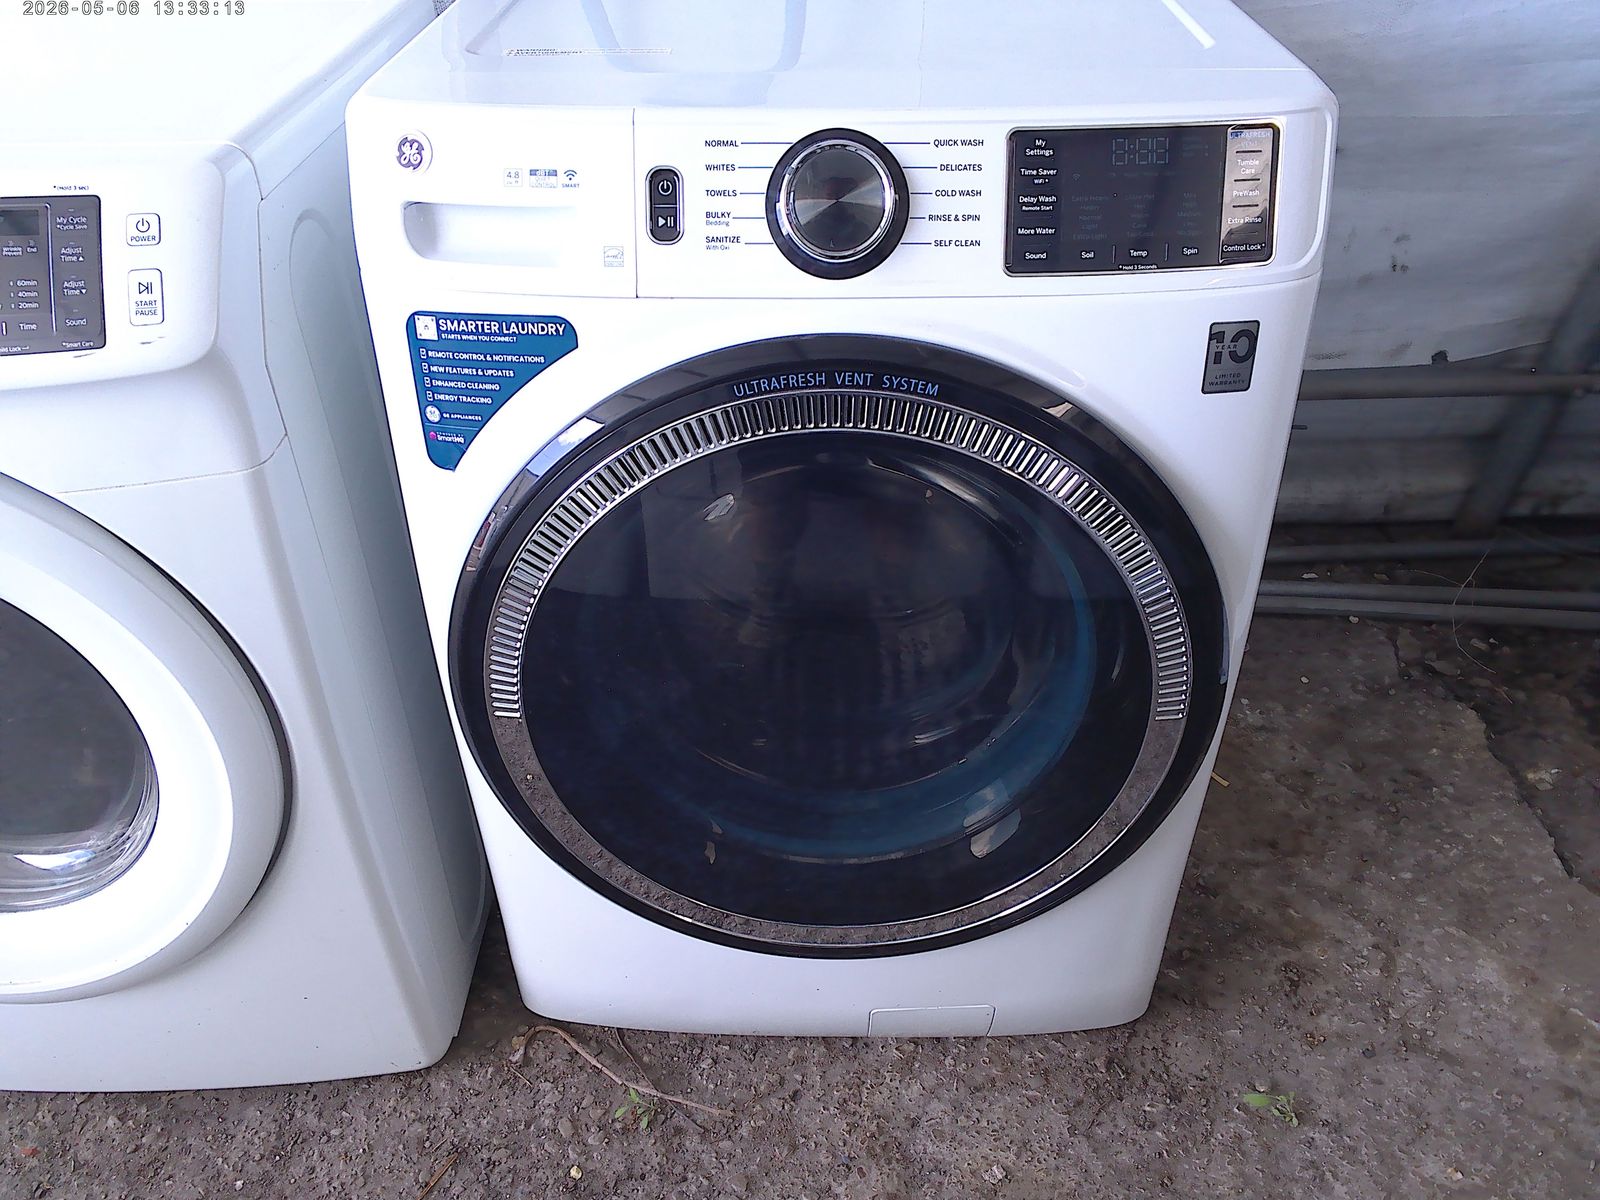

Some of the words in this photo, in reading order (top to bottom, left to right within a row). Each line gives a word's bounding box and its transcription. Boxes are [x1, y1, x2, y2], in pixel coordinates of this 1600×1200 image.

[933, 139, 958, 147] QUICK
[960, 139, 984, 147] WASH
[1035, 139, 1046, 147] My
[1025, 148, 1054, 157] Settings
[940, 164, 983, 172] DELICATES
[1019, 196, 1038, 204] Delay
[56, 216, 67, 224] My
[68, 216, 87, 224] Cycle
[928, 214, 953, 222] RINSE
[954, 214, 960, 222] &
[961, 214, 981, 222] SPIN
[705, 236, 741, 244] SANITIZE
[60, 247, 82, 255] Adjust
[1130, 249, 1148, 257] Temp
[16, 279, 38, 287] 60min
[63, 281, 85, 289] Adjust
[65, 318, 87, 326] Sound
[439, 319, 500, 334] SMARTER
[502, 322, 566, 336] LAUNDRY
[490, 335, 517, 343] CONNECT
[1210, 329, 1257, 364] 10
[427, 350, 454, 359] REMOTE
[454, 352, 485, 361] CONTROL
[492, 354, 545, 363] NOTIFICATIONS
[430, 365, 445, 374] NEW
[445, 366, 477, 376] FEATURES
[477, 368, 483, 376] &
[484, 369, 514, 377] UPDATES
[1215, 372, 1241, 380] LIMITED
[432, 379, 466, 389] ENHANCED
[467, 382, 500, 391] CLEANING
[734, 372, 825, 397] ULTRAFRESH
[835, 372, 874, 386] VENT
[882, 375, 939, 397] SYSTEM
[434, 393, 458, 402] ENERGY
[458, 395, 492, 404] TRACKING
